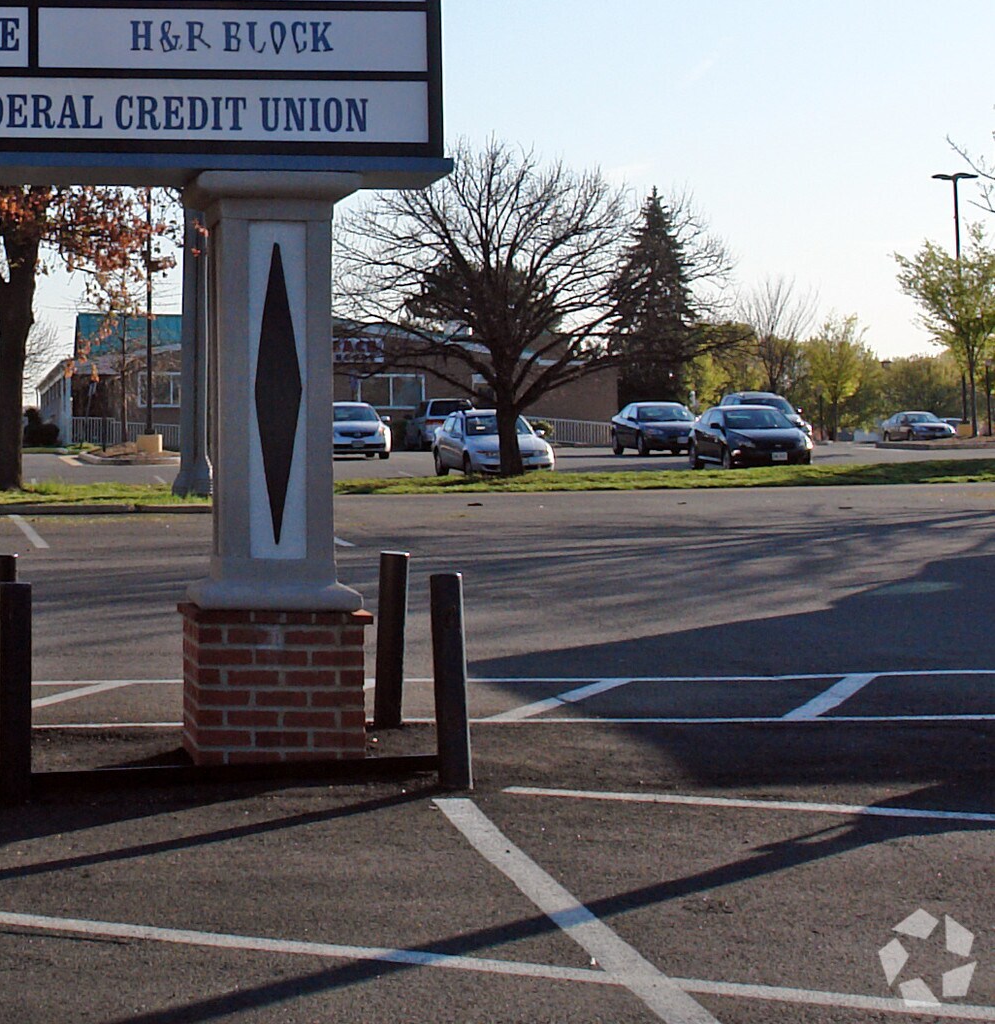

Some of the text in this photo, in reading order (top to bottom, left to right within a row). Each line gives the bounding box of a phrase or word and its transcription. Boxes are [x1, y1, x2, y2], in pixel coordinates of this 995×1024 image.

[129, 20, 334, 55] H&R BLOCK
[115, 94, 247, 132] CREDIT
[258, 96, 369, 133] UNION
